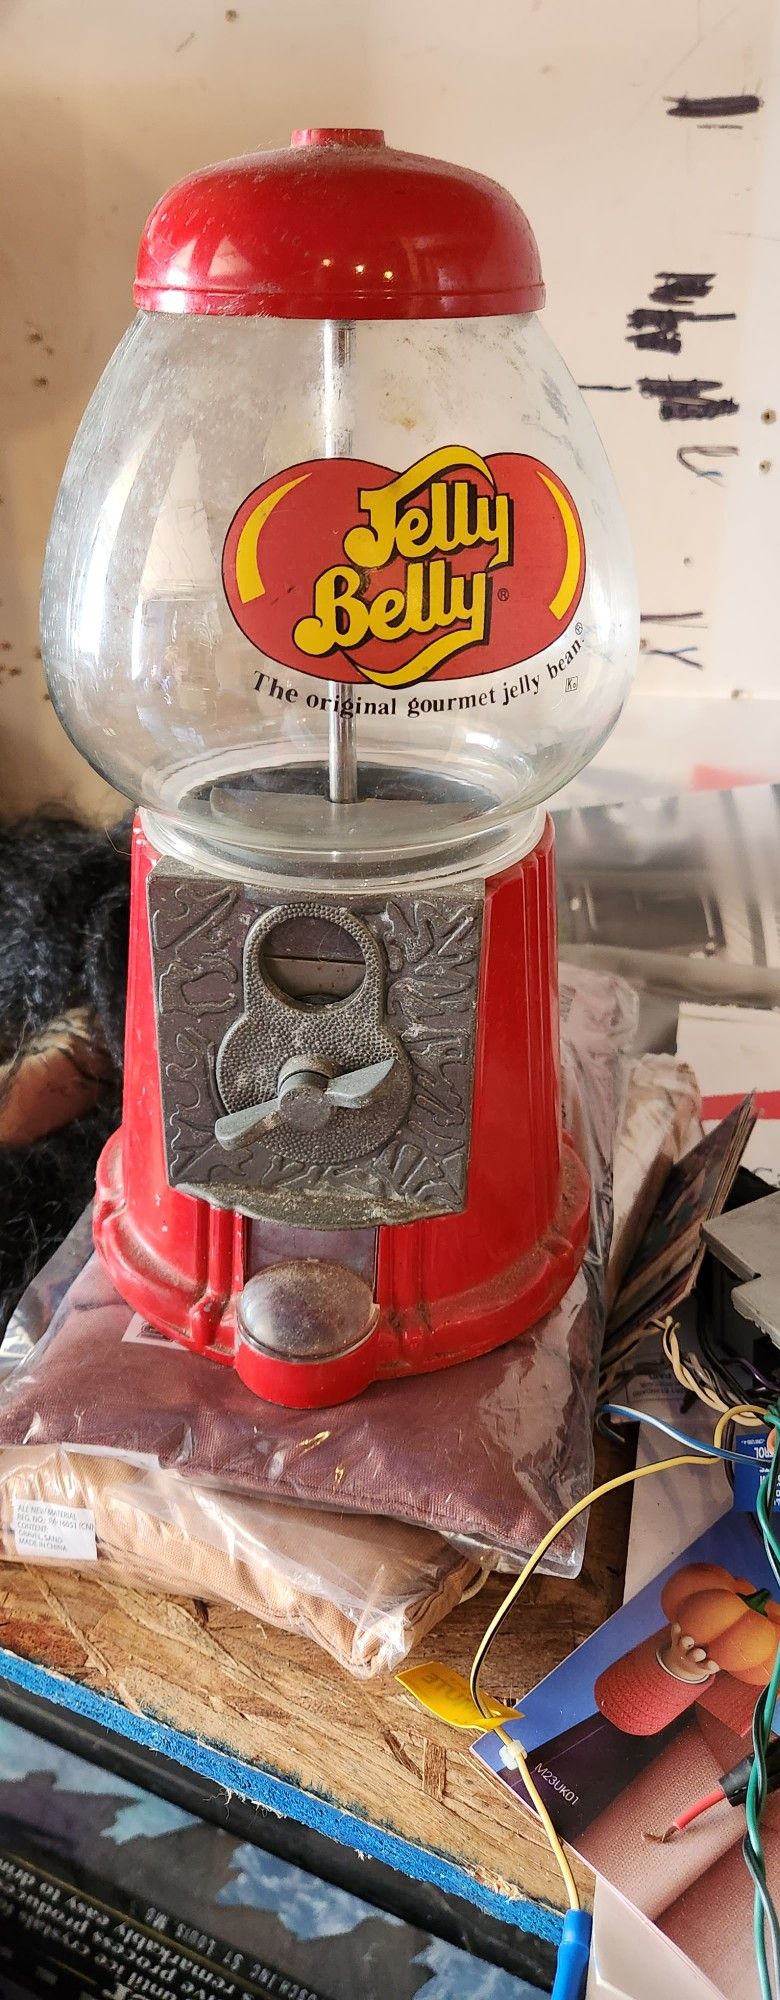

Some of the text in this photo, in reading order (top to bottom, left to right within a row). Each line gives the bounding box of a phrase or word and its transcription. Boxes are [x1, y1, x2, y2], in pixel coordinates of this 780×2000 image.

[343, 478, 513, 569] Jelly
[293, 558, 492, 657] Belly
[253, 669, 298, 703] The
[306, 692, 397, 719] original
[407, 688, 497, 715] gourmet
[502, 675, 541, 707] jelly
[534, 1763, 579, 1806] M23UK01
[0, 1881, 89, 1935] produce
[40, 1882, 60, 1902] to
[65, 1895, 110, 1926] easy
[92, 1930, 178, 1982] process
[114, 1922, 236, 1994] remarkably
